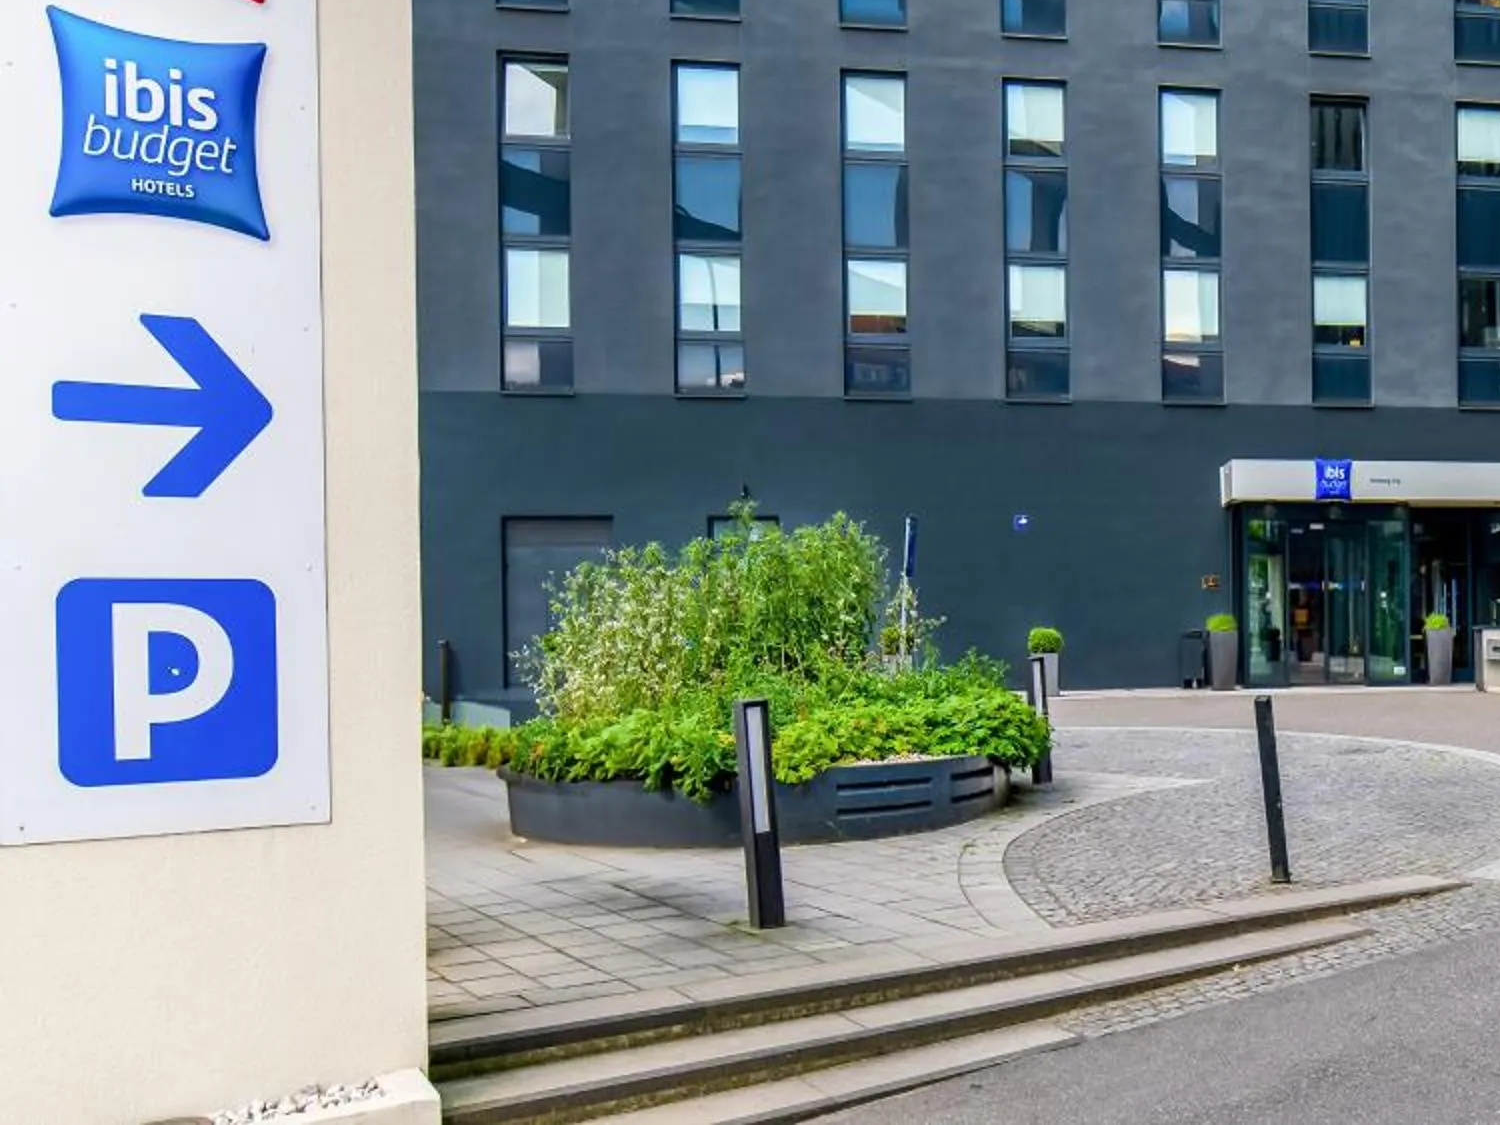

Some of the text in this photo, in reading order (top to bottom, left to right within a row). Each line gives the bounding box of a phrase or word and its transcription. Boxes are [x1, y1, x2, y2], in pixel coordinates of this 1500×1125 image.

[104, 58, 219, 132] ibis
[82, 113, 237, 177] budget
[131, 178, 196, 199] HOTELS
[111, 601, 235, 761] P
